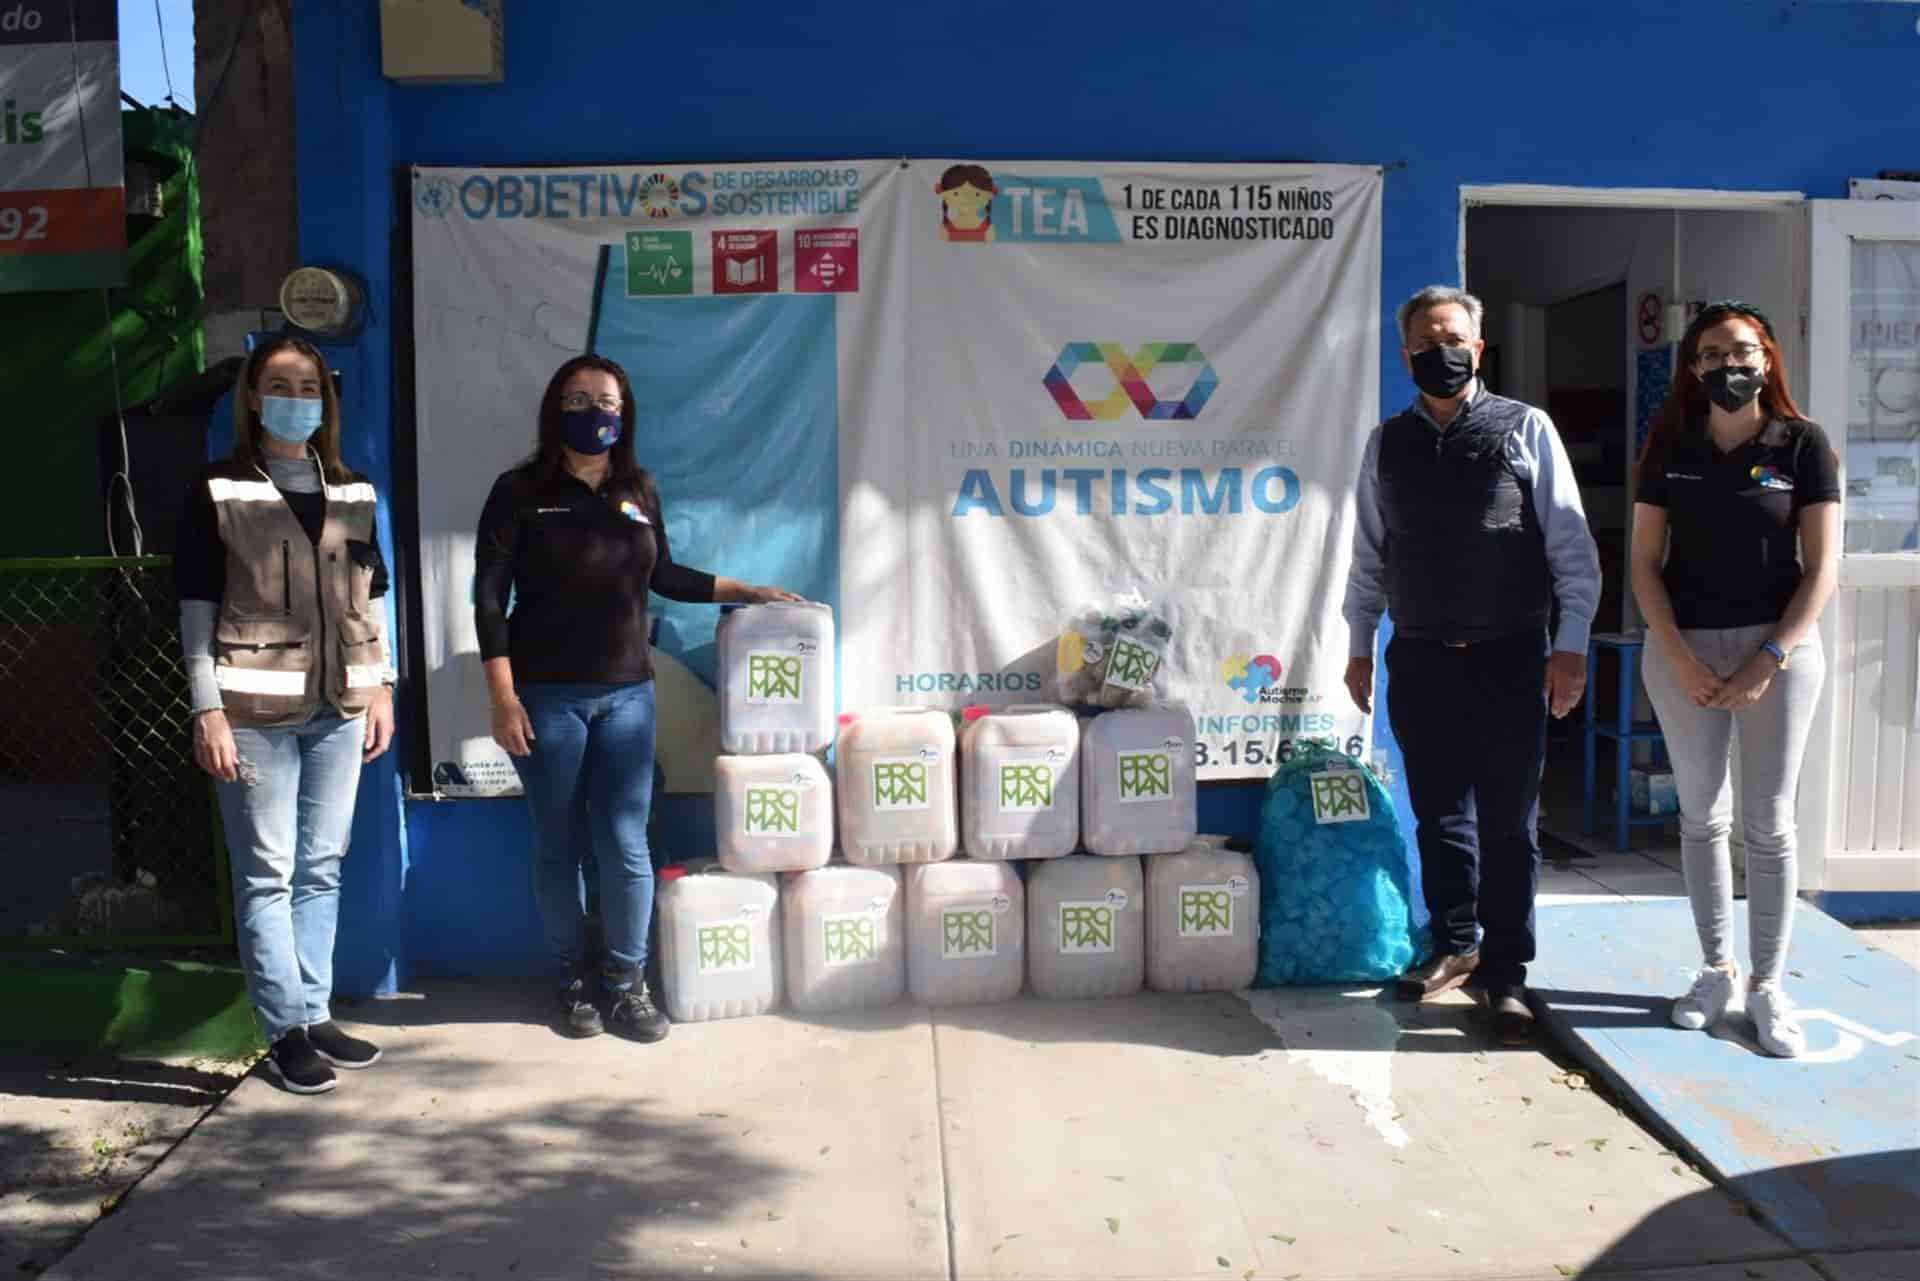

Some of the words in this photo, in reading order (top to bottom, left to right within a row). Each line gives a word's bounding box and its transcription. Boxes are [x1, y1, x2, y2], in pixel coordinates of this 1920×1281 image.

[712, 171, 743, 190] DE
[743, 168, 859, 190] DESARROLLO
[459, 172, 707, 220] OBJETIVOS
[711, 189, 860, 218] SOSTENIBLE
[1121, 184, 1133, 211] 1
[1142, 189, 1168, 211] DE
[1170, 189, 1222, 211] CADA
[1230, 184, 1273, 211] 115
[1277, 186, 1334, 212] NIÑOS
[1003, 186, 1090, 237] TEA
[1131, 216, 1160, 241] ES
[1165, 216, 1335, 241] DIAGNOSTICADO
[950, 440, 999, 459] UNA
[1132, 440, 1205, 458] NUEVA
[1210, 439, 1272, 458] PARA
[950, 464, 1302, 518] AUTISMO
[895, 671, 1042, 694] HORARIOS
[1199, 713, 1335, 735] INFORMES
[1312, 775, 1363, 797] PRO
